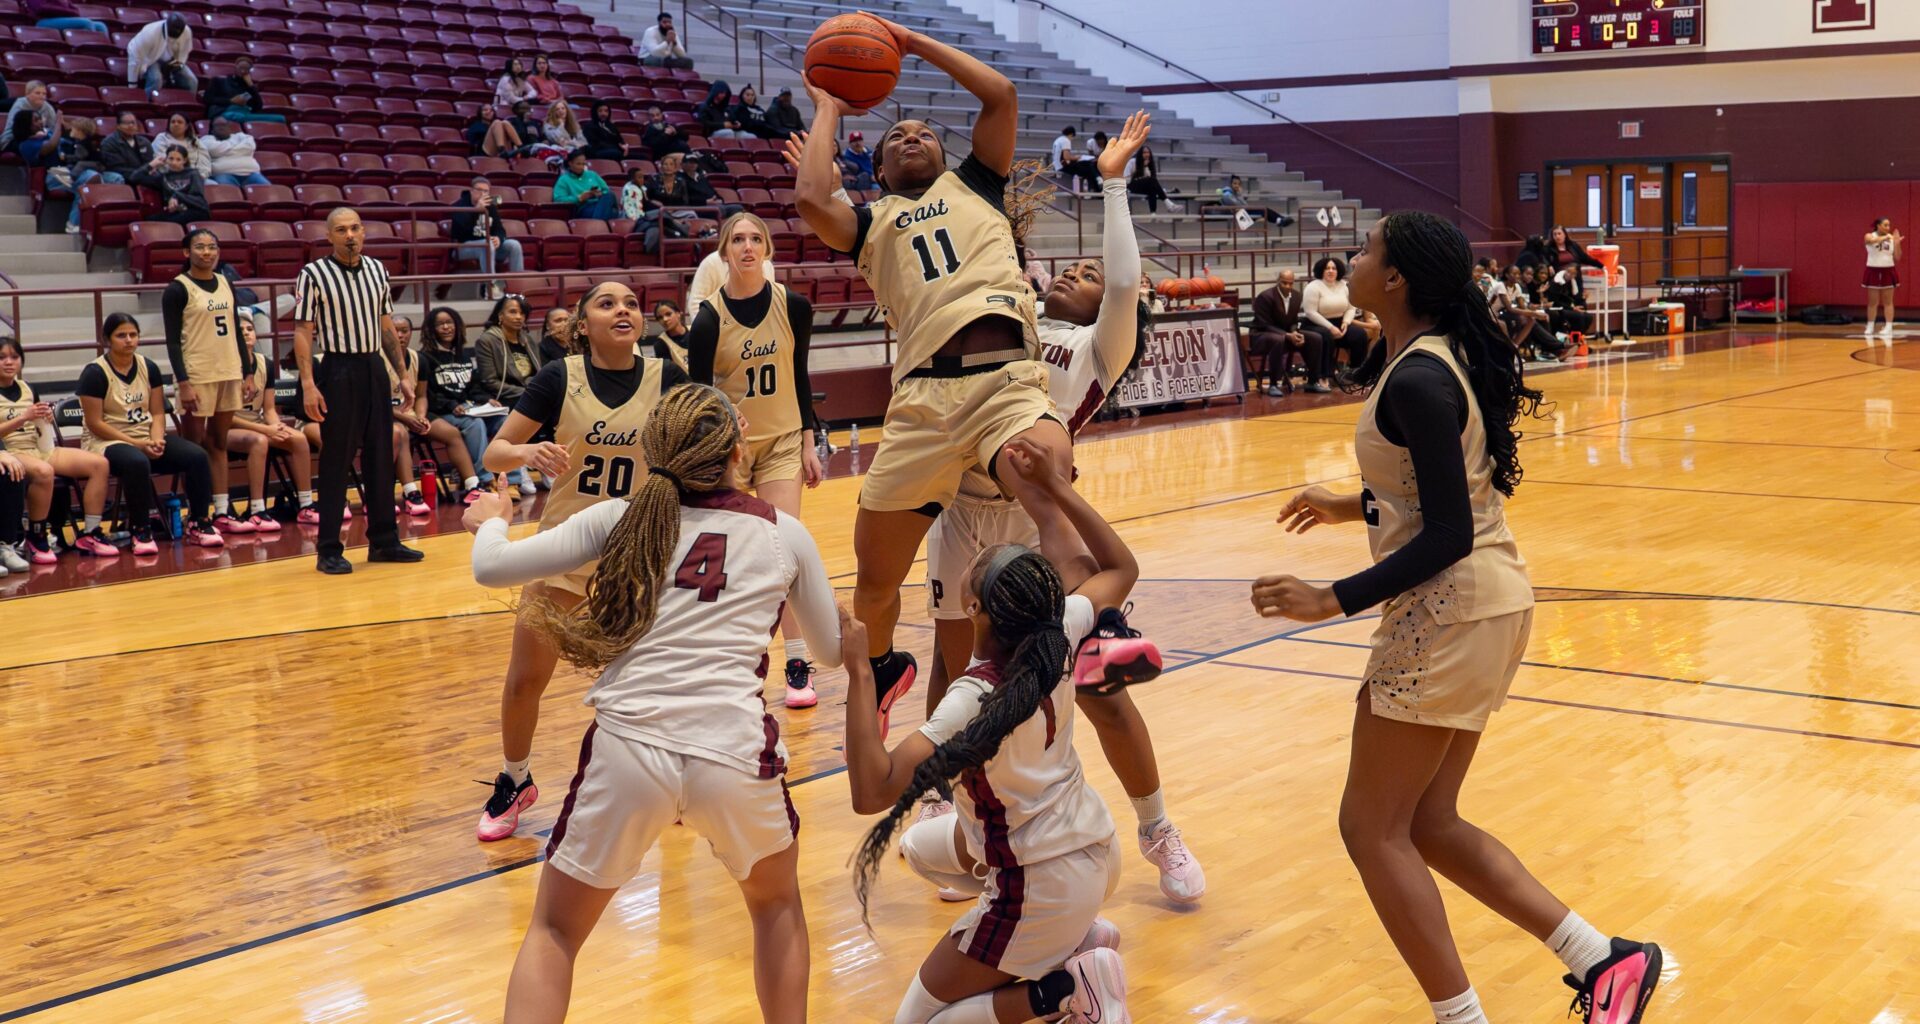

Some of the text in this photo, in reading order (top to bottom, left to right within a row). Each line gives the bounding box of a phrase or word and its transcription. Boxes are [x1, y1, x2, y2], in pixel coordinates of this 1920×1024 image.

[1539, 18, 1558, 27] FOULS
[1590, 12, 1642, 24] PLAYER FOULS
[1673, 9, 1694, 19] FOULS
[1571, 25, 1580, 39] 2
[1651, 20, 1659, 33] 3
[895, 198, 949, 229] East
[911, 227, 961, 282] 11
[206, 299, 229, 312] East
[214, 315, 229, 337] 5
[741, 339, 778, 360] East
[745, 363, 777, 398] 10
[1153, 381, 1163, 397] IS
[1169, 375, 1218, 395] FOREVER
[584, 420, 638, 446] East
[577, 454, 635, 498] 20
[674, 532, 728, 602] 4
[931, 579, 944, 608] P
